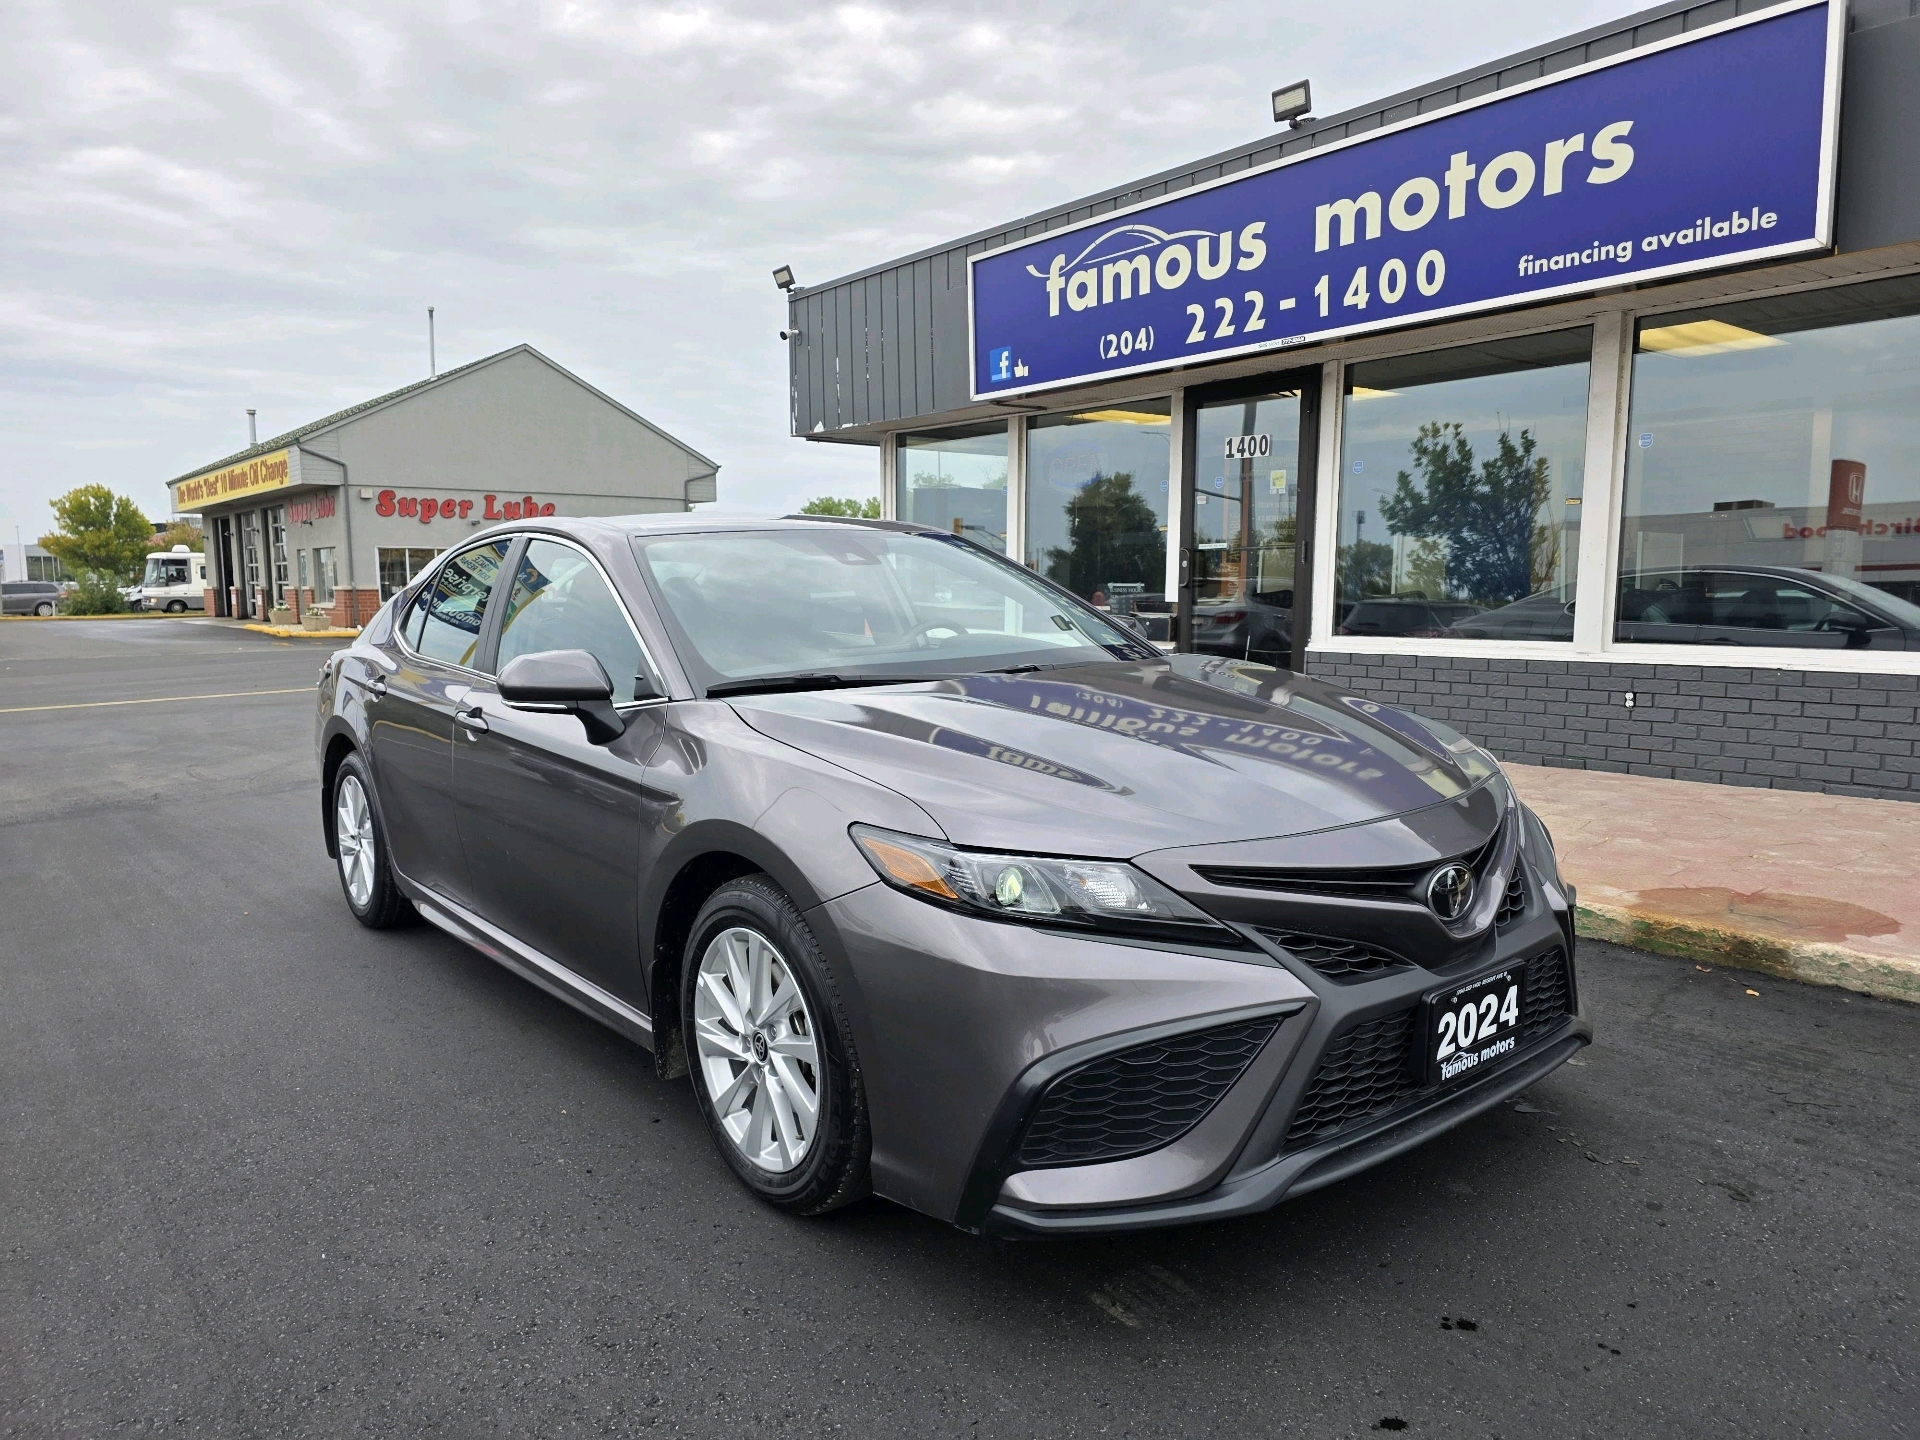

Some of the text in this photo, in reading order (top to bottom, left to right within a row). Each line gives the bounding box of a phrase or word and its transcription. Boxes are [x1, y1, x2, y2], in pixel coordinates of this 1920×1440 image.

[1034, 120, 1635, 318] famous motors
[1518, 206, 1779, 277] financing available
[1099, 325, 1155, 360] (204)
[1225, 434, 1269, 459] 1400
[176, 485, 186, 504] The
[220, 472, 228, 493] 10
[228, 468, 248, 491] Minute
[250, 461, 259, 487] Oil
[260, 458, 288, 485] Change
[288, 490, 336, 526] Super Lube
[376, 489, 556, 524] Super Lube
[1436, 984, 1519, 1061] 2024
[1441, 1036, 1515, 1081] famous motors
